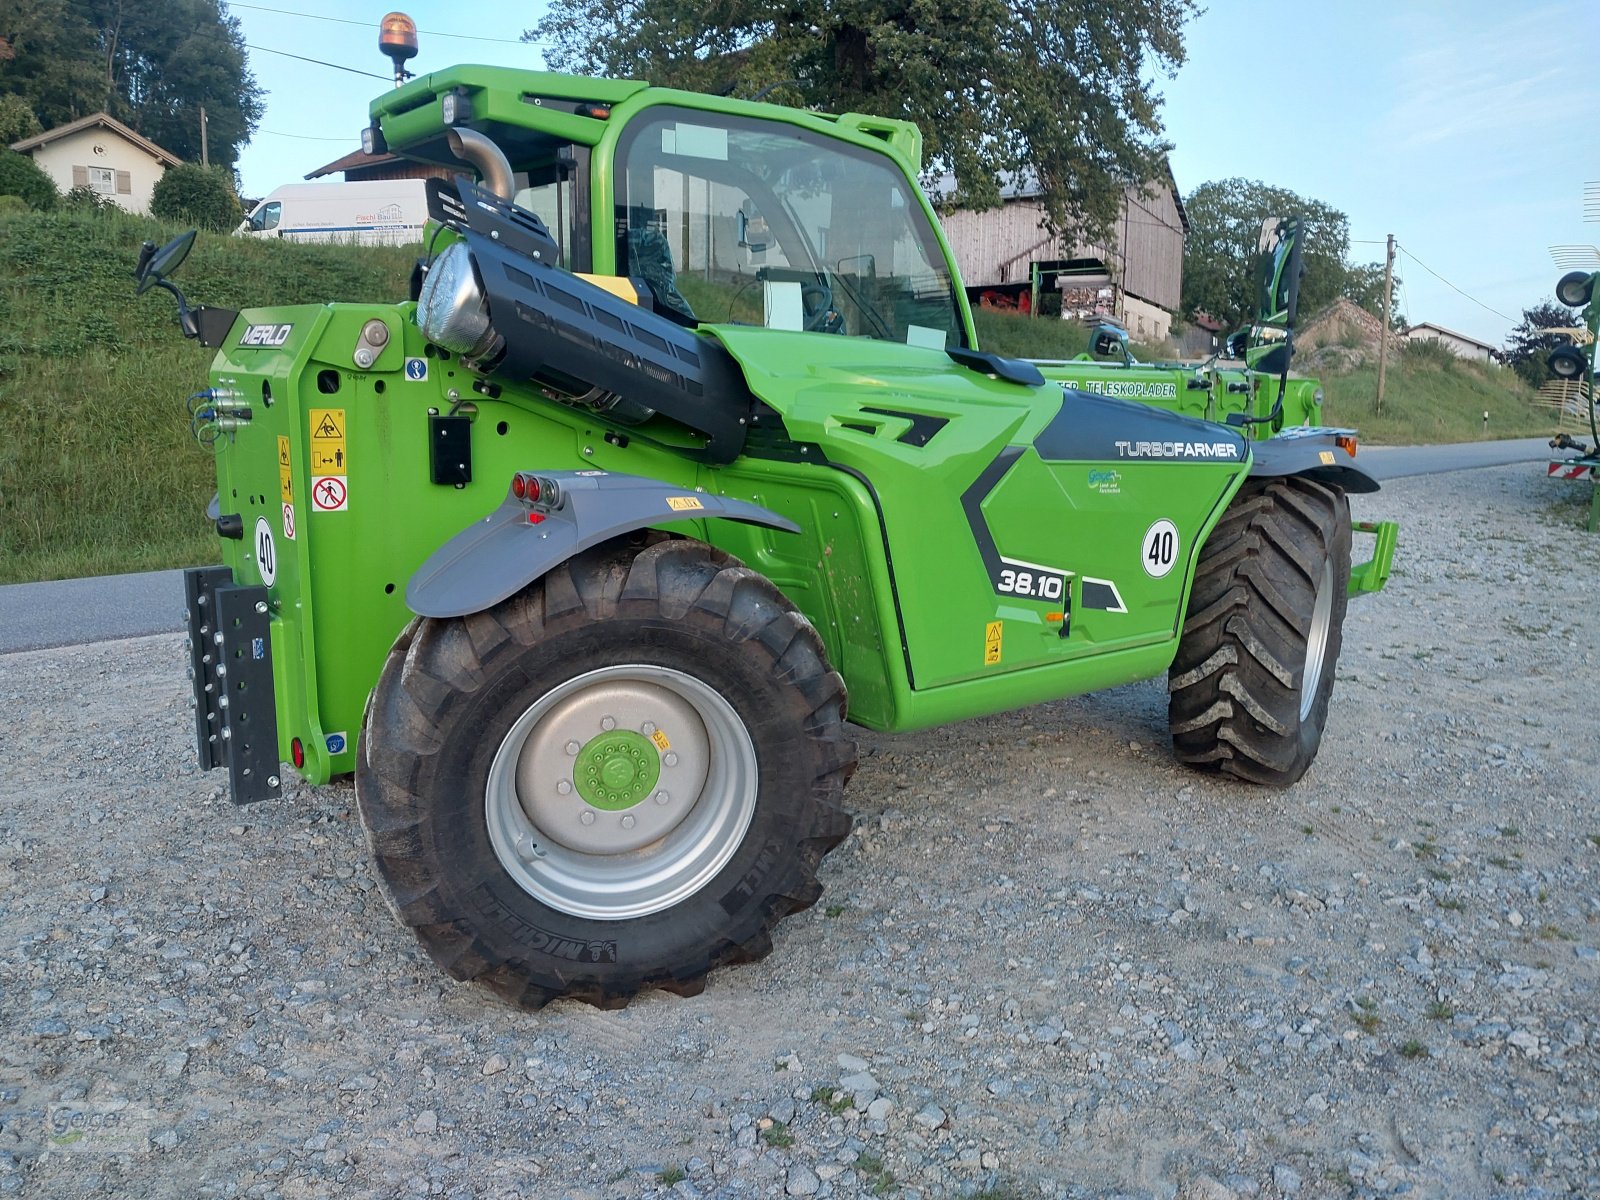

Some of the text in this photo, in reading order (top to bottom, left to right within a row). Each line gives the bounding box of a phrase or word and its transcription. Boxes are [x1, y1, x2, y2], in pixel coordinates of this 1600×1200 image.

[240, 324, 292, 346] MERLO
[1087, 381, 1177, 398] TELESKOPLADER
[1115, 441, 1237, 458] TURBOFARMER
[259, 532, 273, 575] 40
[1148, 531, 1173, 566] 40
[998, 570, 1063, 599] 38.10
[468, 884, 585, 961] MICHELIN
